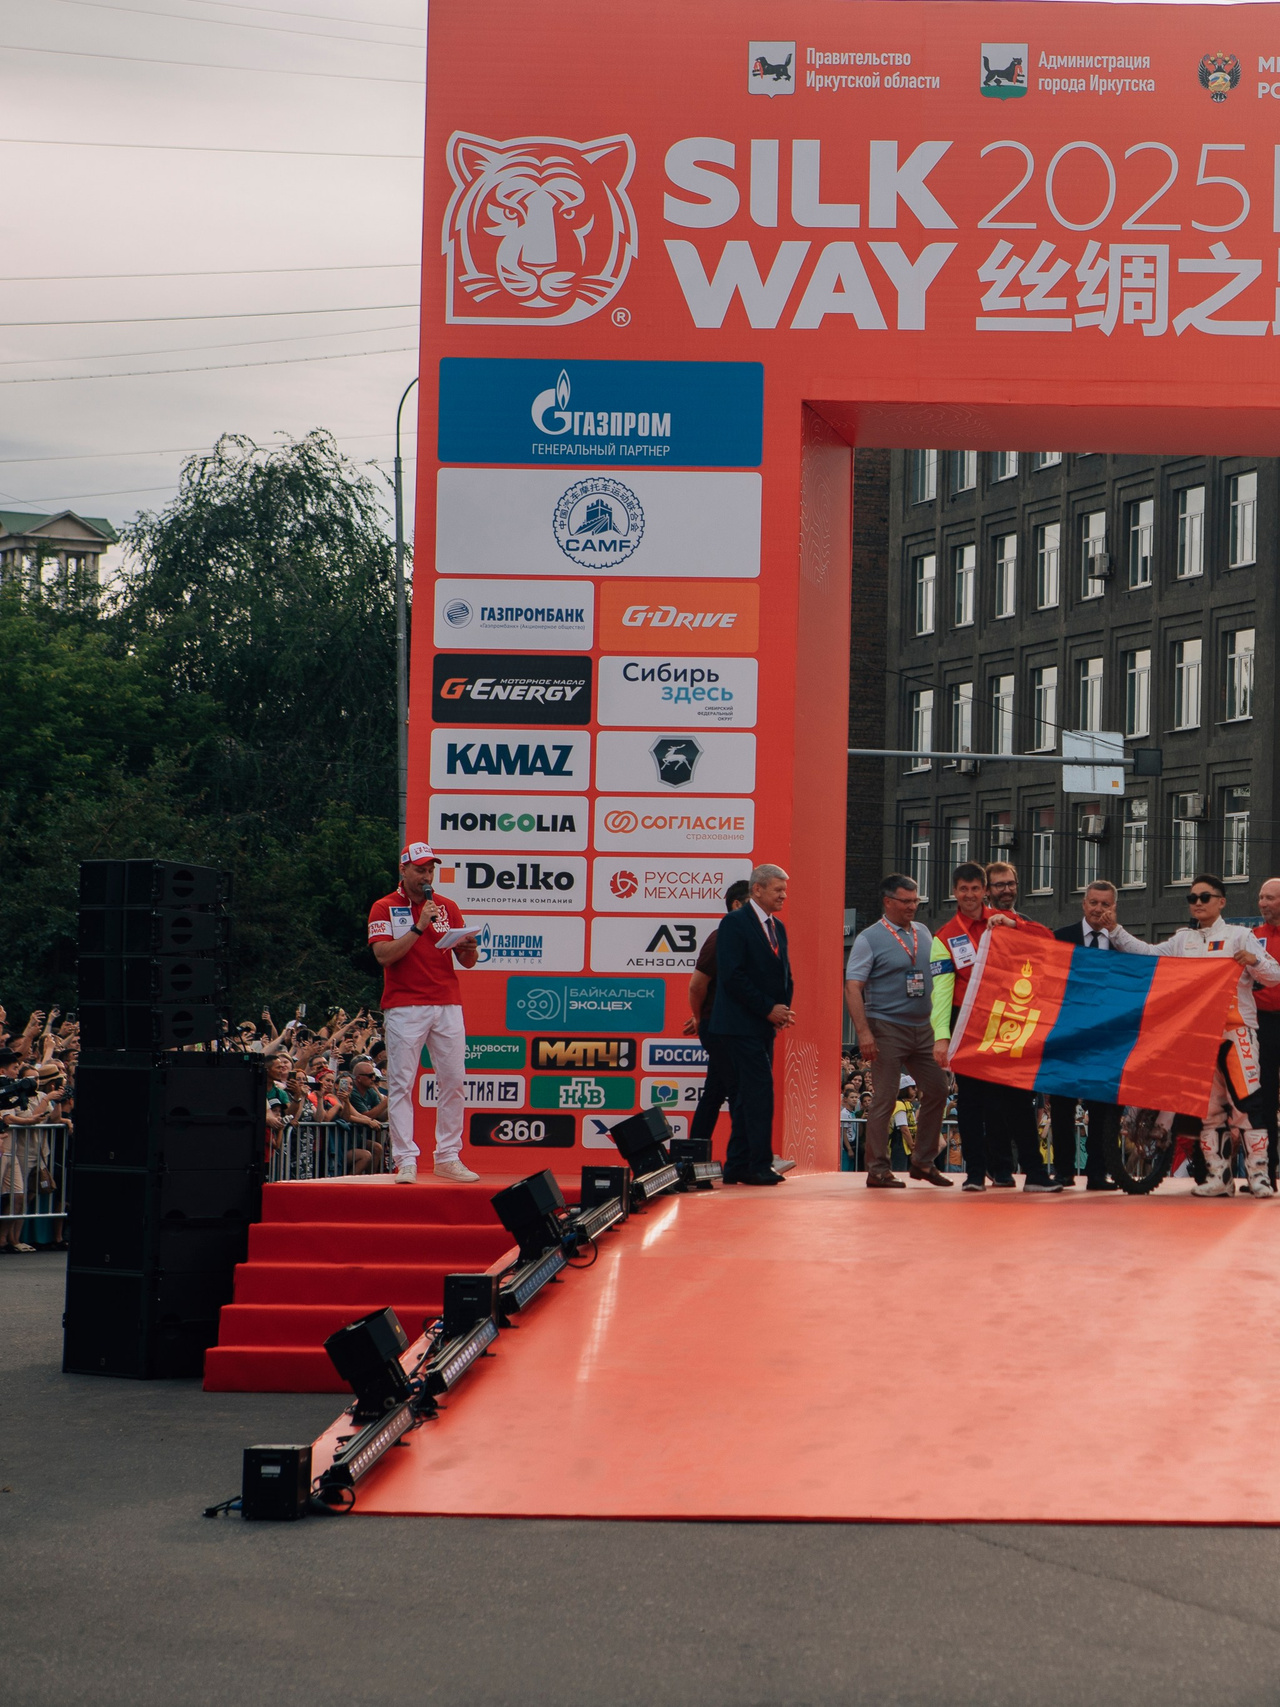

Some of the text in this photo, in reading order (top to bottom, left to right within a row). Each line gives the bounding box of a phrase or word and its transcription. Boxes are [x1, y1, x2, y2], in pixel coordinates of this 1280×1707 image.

[807, 47, 911, 68] Правительство
[1038, 51, 1150, 72] Администрация
[806, 71, 940, 91] Иркутской области
[1038, 75, 1155, 96] города Иркутска
[663, 136, 959, 229] SILK
[977, 140, 1250, 233] 2025
[663, 239, 959, 330] WAY
[573, 411, 671, 437] ГАЗПРОМ
[532, 443, 671, 457] ГЕНЕРАЛЬНЫЙ ПАРТНЕР
[558, 482, 640, 533] 中国汽车摩托车运动联合会
[566, 539, 631, 552] CAMF
[481, 607, 585, 622] ГАЗПРОМБАНК
[622, 662, 719, 686] Сибирь
[661, 686, 734, 704] здесь
[446, 743, 574, 776] KAMAZ
[440, 812, 576, 833] MONGOLIA
[641, 815, 745, 831] СОГЛАСИЕ
[686, 833, 745, 841] страхование
[465, 862, 575, 891] Delko
[644, 871, 724, 884] РУССКАЯ
[644, 887, 726, 899] МЕХАНИК
[492, 935, 543, 948] ГАЗПРОМ
[493, 949, 542, 957] ДОБЫЧА
[627, 958, 696, 967] ЛЕНЗОЛО
[570, 987, 655, 998] БАЙКАЛЬСК
[569, 1001, 632, 1011] ЭКО.ЦЕХ
[1236, 1027, 1252, 1059] KFC
[539, 1041, 629, 1068] МАТЧ!
[654, 1048, 709, 1062] РОССИЯ
[559, 1077, 606, 1108] НТВ
[499, 1120, 546, 1141] 360
